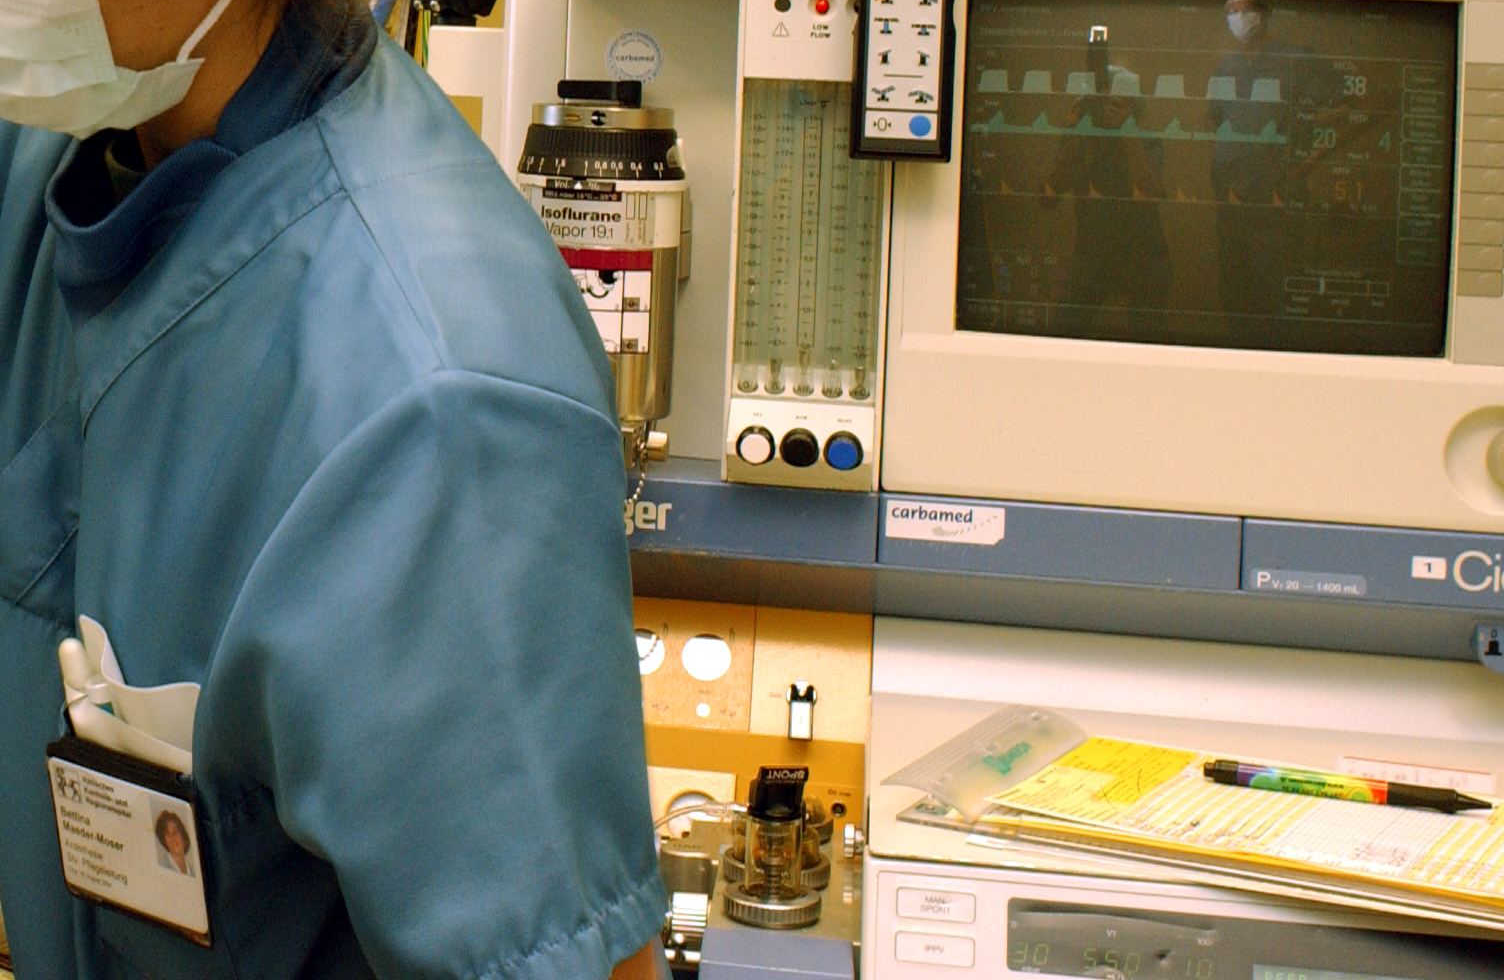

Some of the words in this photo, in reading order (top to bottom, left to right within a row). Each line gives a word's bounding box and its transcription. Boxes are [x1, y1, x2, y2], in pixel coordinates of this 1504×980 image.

[1343, 75, 1366, 96] 38
[1313, 128, 1336, 149] 20
[541, 204, 622, 223] Isoflurane
[546, 221, 587, 239] Vapor
[892, 504, 974, 524] carbamed
[1453, 550, 1504, 592] Ci
[1285, 580, 1300, 591] 20
[1317, 582, 1342, 593] 1400
[1343, 584, 1361, 595] mL
[60, 806, 91, 826] Bettina
